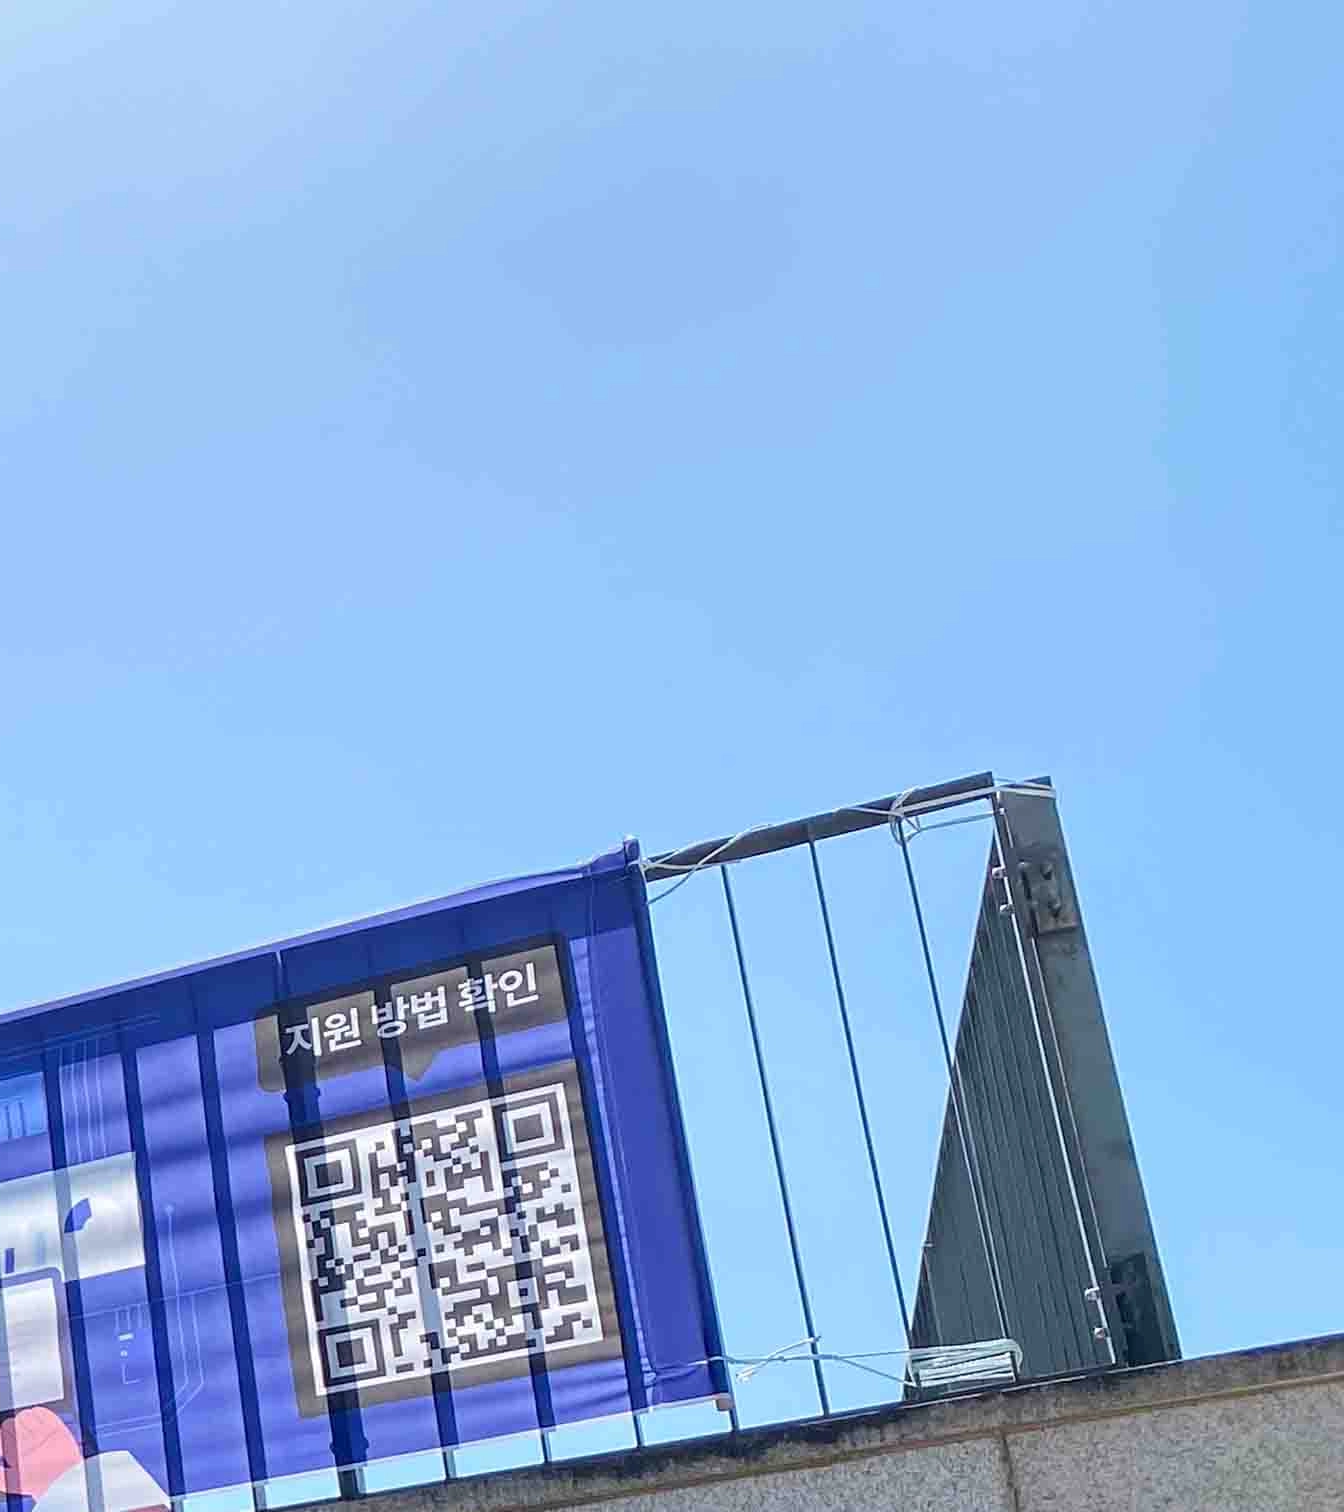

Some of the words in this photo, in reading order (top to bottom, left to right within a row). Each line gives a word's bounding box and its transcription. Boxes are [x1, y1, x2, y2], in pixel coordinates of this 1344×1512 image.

[284, 1005, 362, 1057] 지원
[371, 985, 447, 1038] 방법
[458, 961, 539, 1014] 확인
